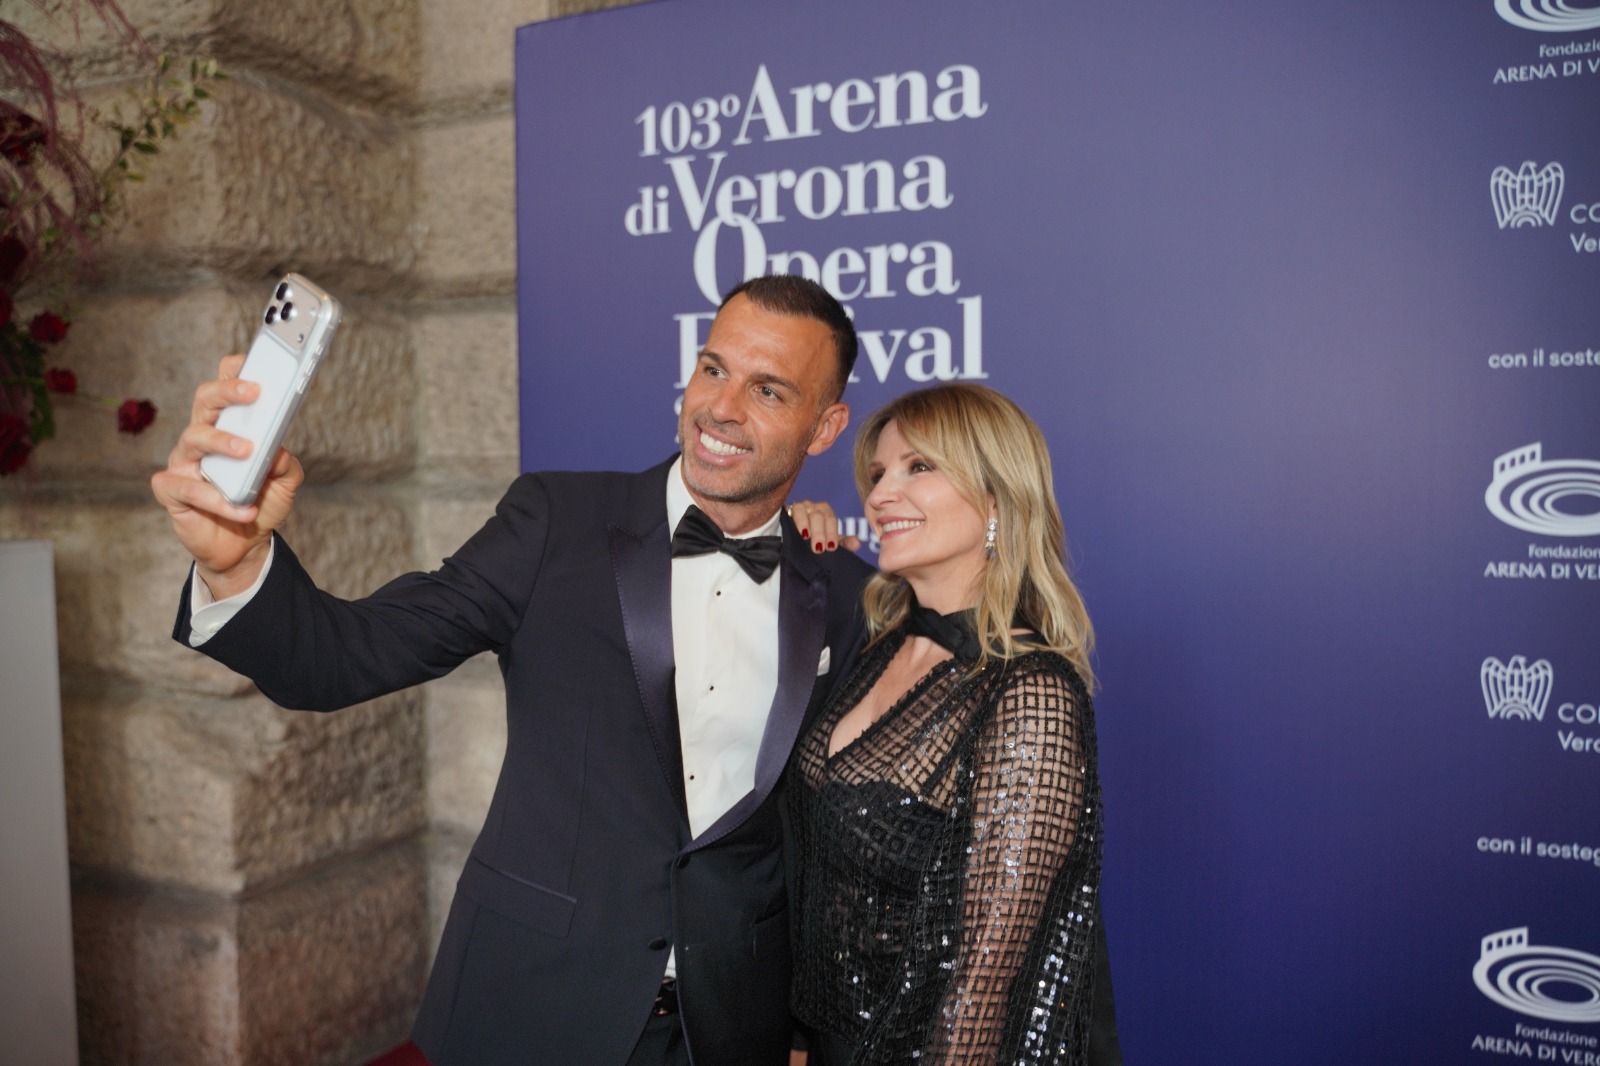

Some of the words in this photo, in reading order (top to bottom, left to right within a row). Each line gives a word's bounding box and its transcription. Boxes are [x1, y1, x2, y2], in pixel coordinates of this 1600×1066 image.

[1493, 62, 1557, 84] ARENA
[1563, 60, 1582, 77] DI
[733, 63, 989, 147] Arena
[624, 185, 672, 237] di
[664, 151, 954, 232] Verona
[1488, 353, 1528, 369] con
[1533, 347, 1544, 368] il
[1484, 561, 1547, 579] ARENA
[1551, 563, 1570, 580] DI
[1477, 836, 1515, 854] con
[1521, 836, 1532, 856] il
[1471, 1034, 1533, 1058] ARENA
[1538, 1044, 1557, 1061] DI
[1515, 1023, 1598, 1049] Fondazione
